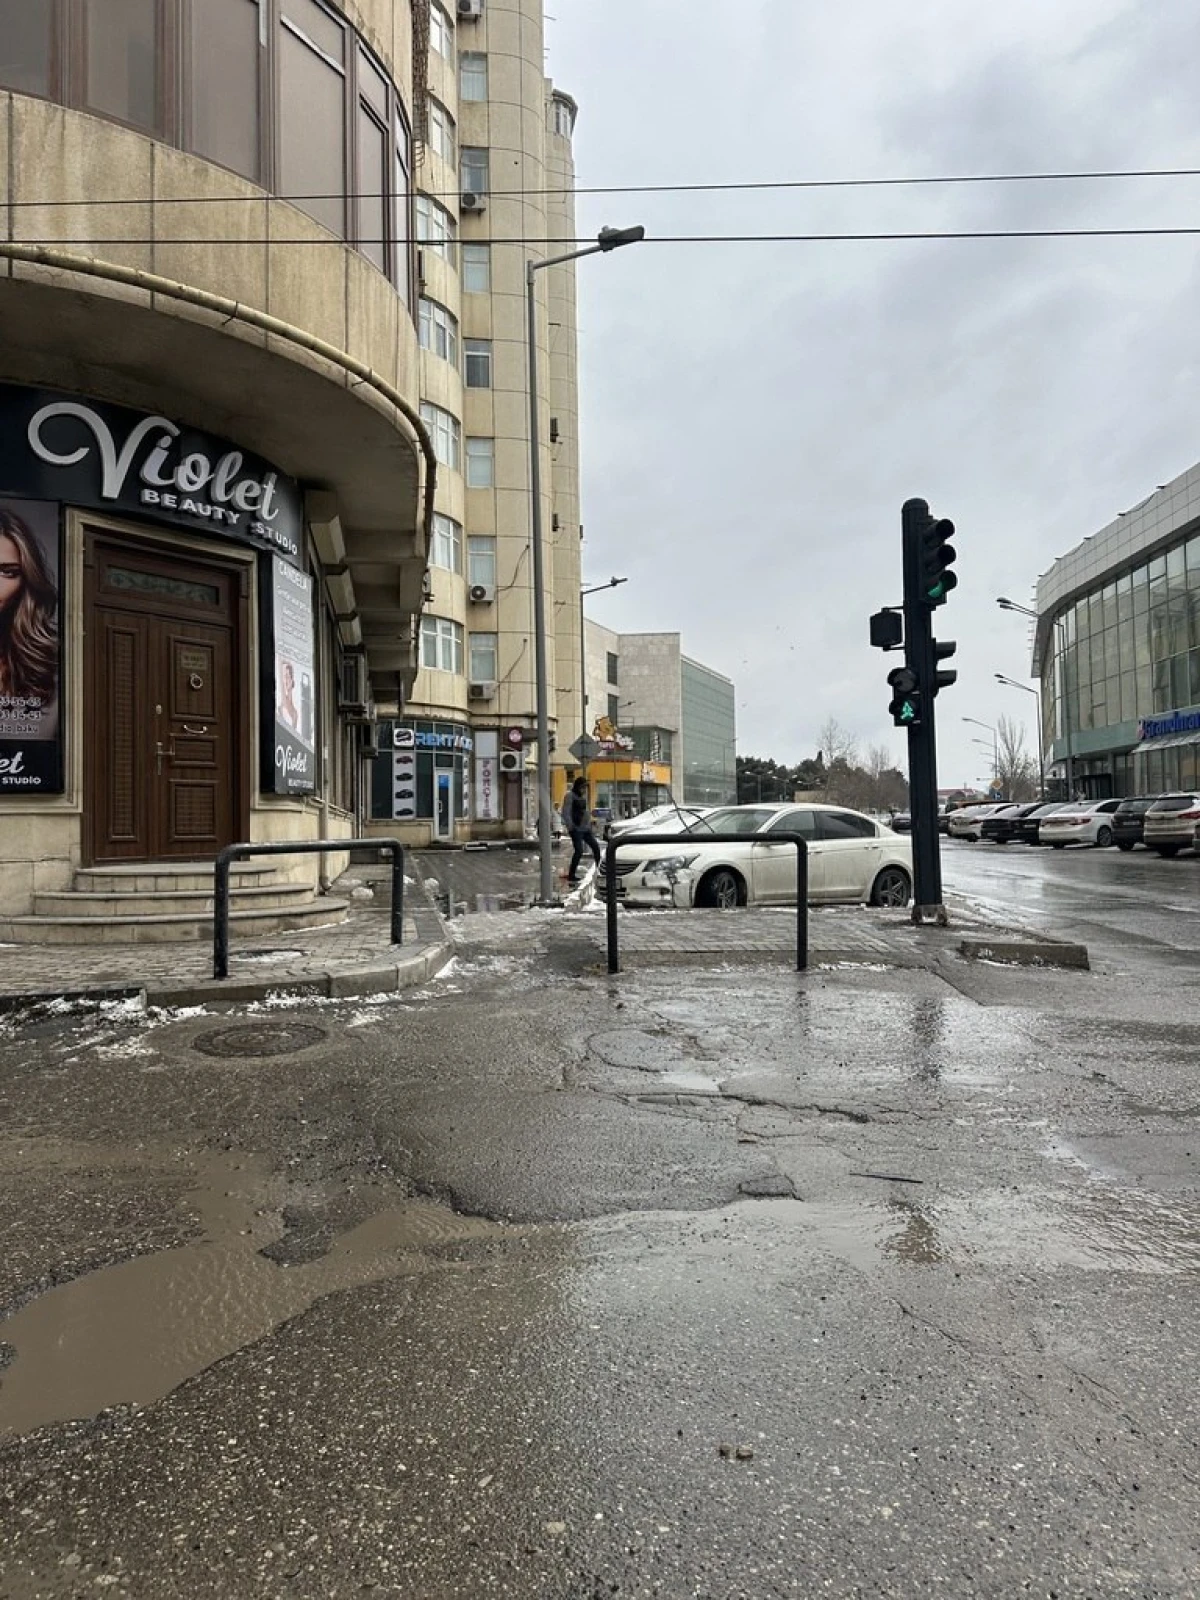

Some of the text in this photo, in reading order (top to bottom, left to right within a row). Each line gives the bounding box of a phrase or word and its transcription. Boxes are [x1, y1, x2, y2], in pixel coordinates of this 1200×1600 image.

[27, 402, 282, 520] Violet
[141, 488, 299, 556] BEAUTY STUDIO
[2, 776, 42, 785] STUDIO
[276, 744, 307, 778] Violet
